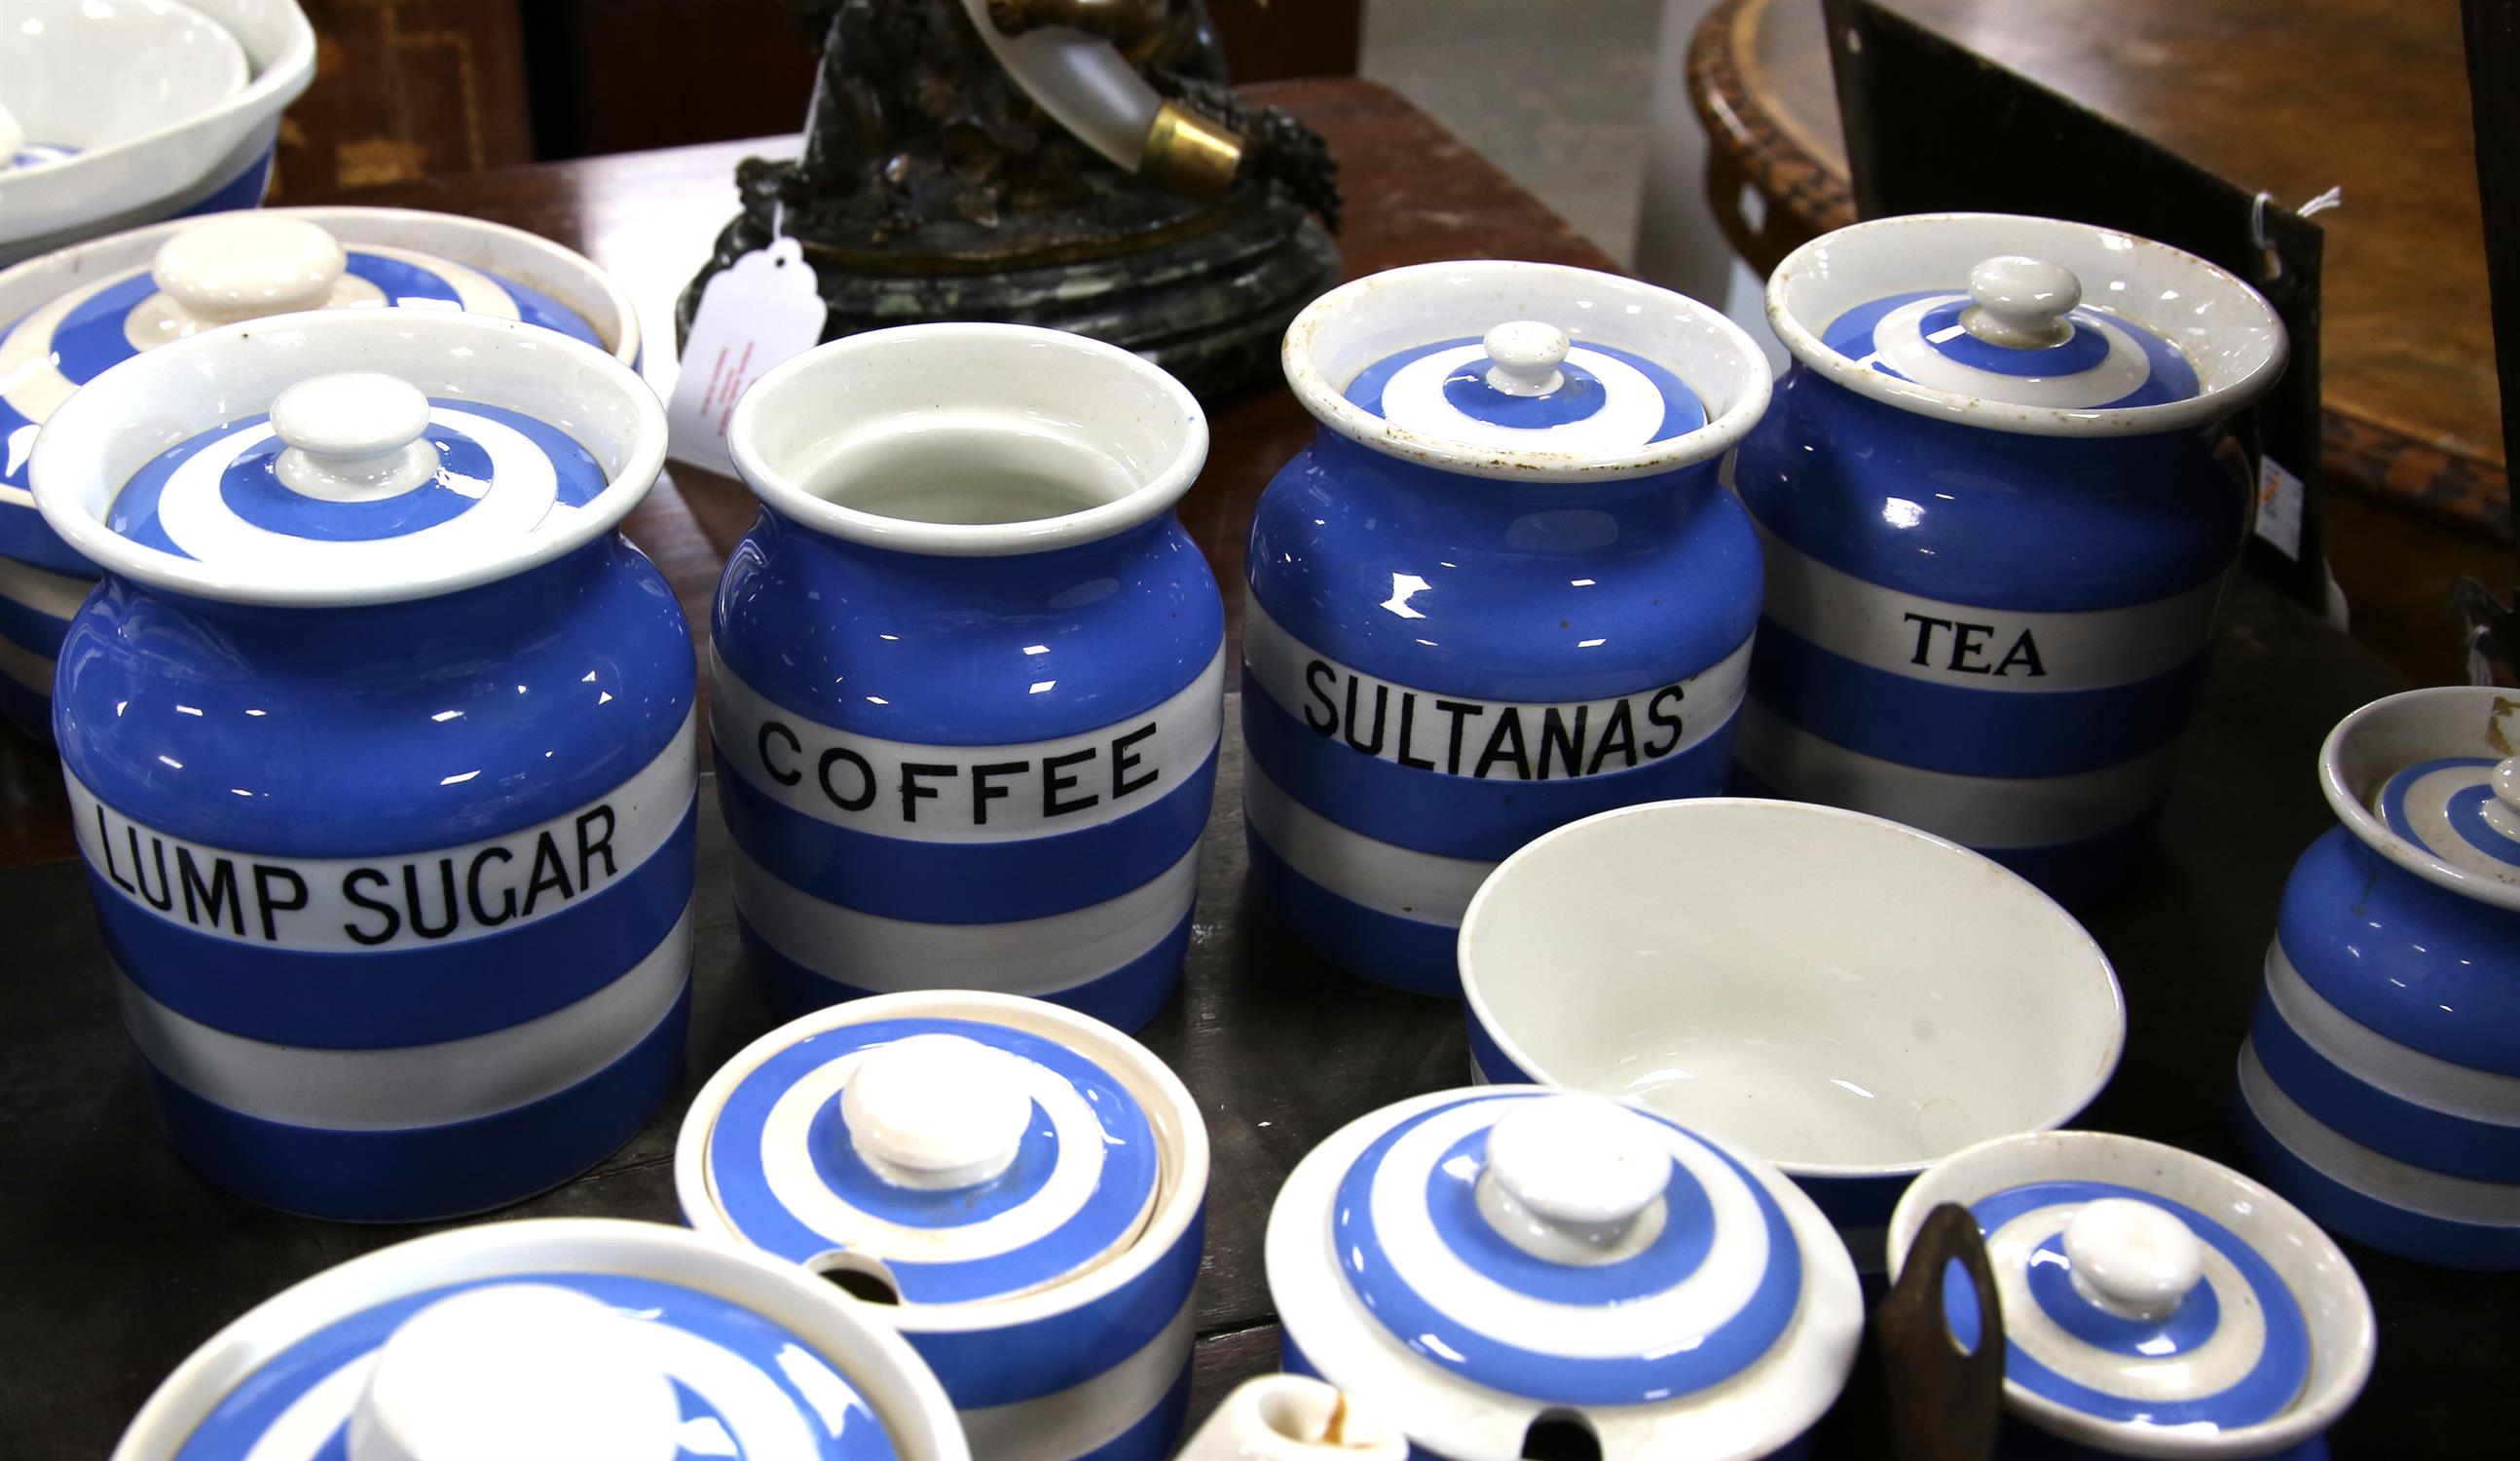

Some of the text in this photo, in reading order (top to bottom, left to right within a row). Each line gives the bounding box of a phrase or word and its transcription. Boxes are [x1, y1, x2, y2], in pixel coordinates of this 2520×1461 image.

[1904, 612, 2047, 677] TEA
[758, 721, 1160, 825] COFFEE
[1303, 659, 1685, 781] SULTANAS
[95, 803, 619, 946] LUMP SUGAR
